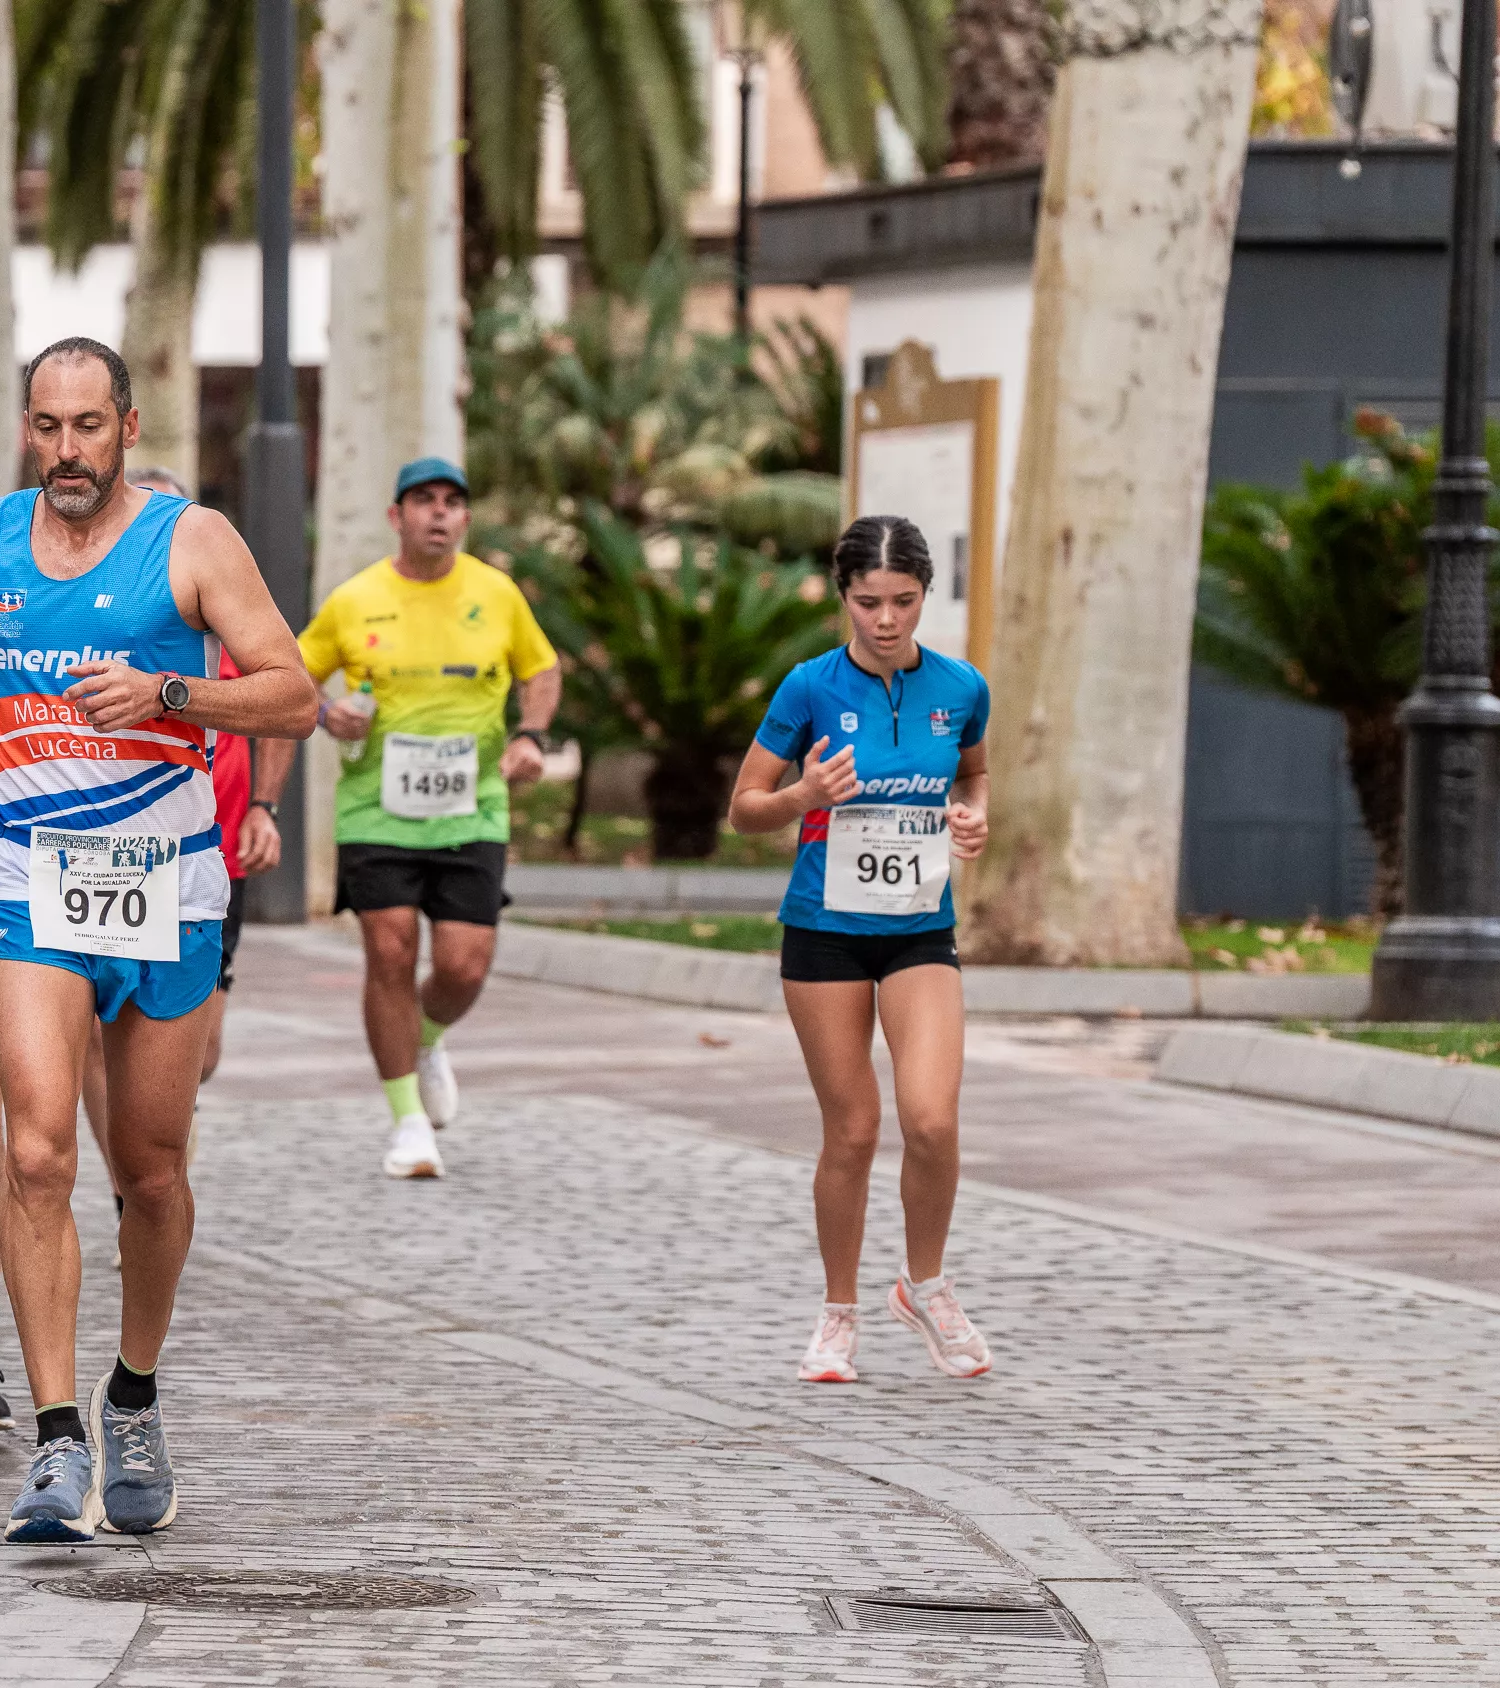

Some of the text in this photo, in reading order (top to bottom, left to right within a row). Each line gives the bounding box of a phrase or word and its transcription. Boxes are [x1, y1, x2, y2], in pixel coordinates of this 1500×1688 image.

[13, 698, 90, 725] Marat
[25, 737, 117, 760] Lucena
[399, 771, 467, 796] 1498
[36, 831, 64, 841] CIRCUITO
[65, 834, 101, 844] PROVINCIAL
[36, 838, 110, 851] CARRERAS POPULARES
[112, 836, 150, 851] 2024
[857, 853, 921, 885] 961
[64, 887, 147, 928] 970
